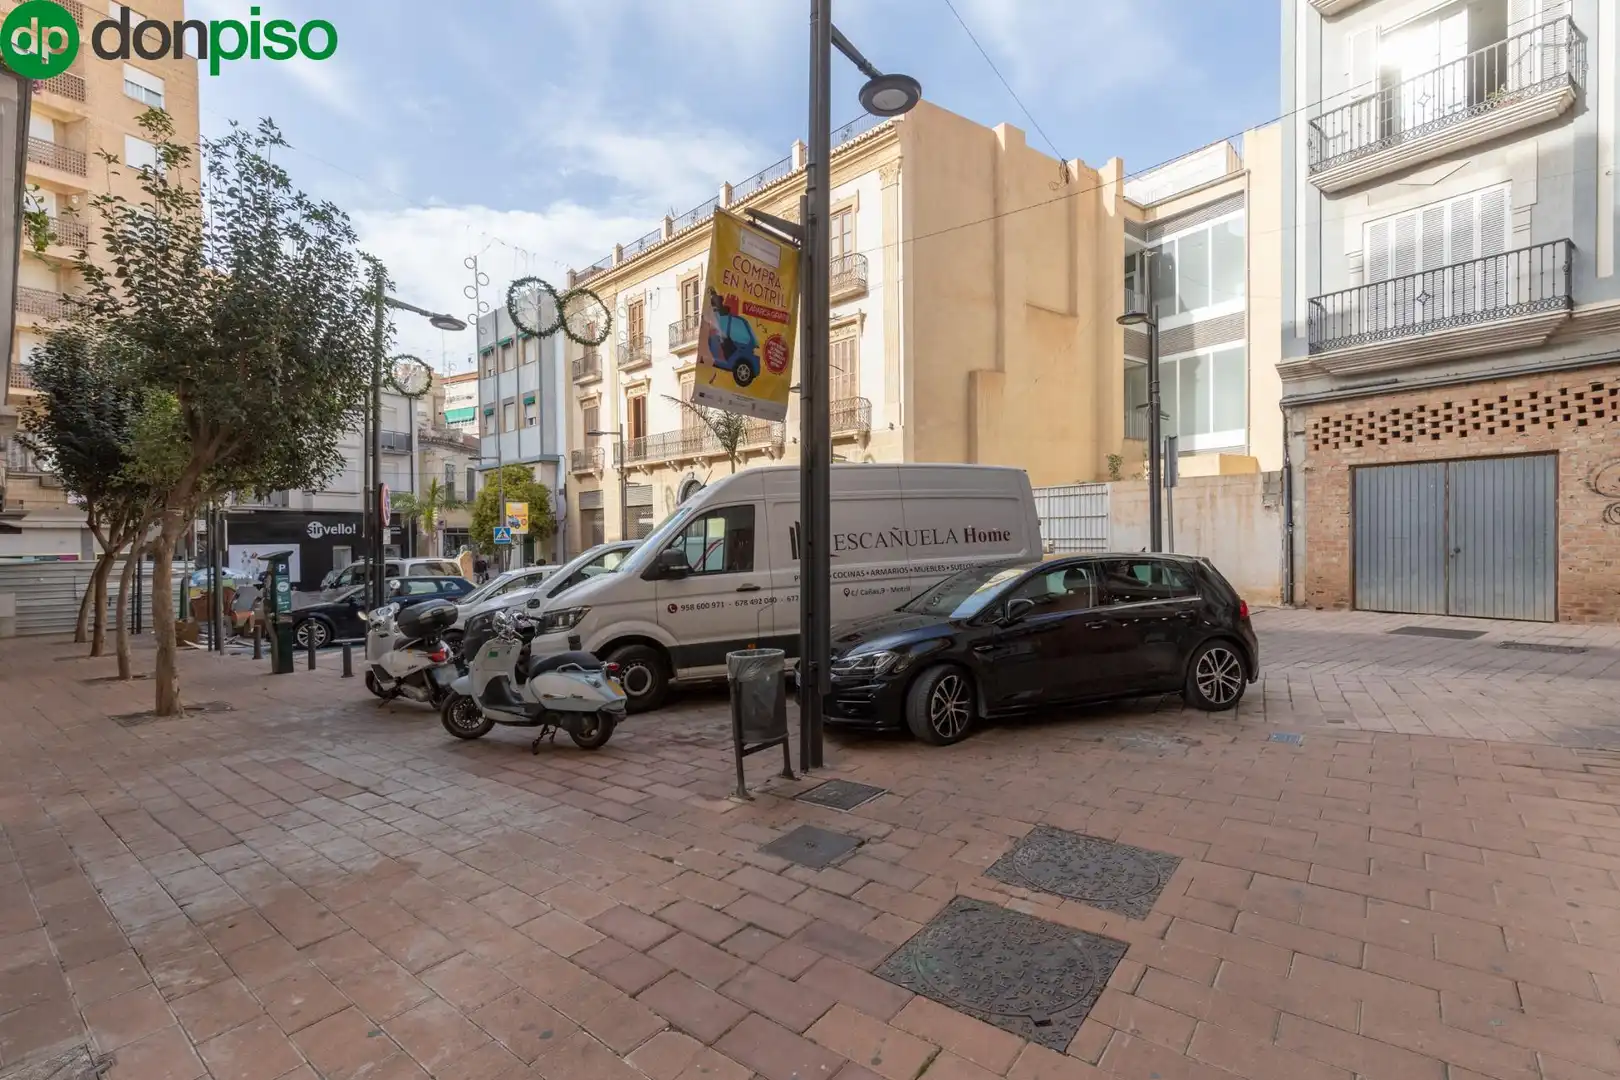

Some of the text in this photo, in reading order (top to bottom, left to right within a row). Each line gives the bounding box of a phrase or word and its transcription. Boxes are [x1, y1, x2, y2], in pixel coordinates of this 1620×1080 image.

[732, 255, 782, 290] COMPRA
[722, 269, 787, 308] EN MOTRIL
[306, 522, 357, 536] sinvello!
[833, 525, 1011, 551] ESCAÑUELA Home
[278, 563, 287, 573] P
[832, 571, 866, 579] COCINAS
[870, 567, 909, 577] ARMARIOS
[913, 565, 946, 573] MUEBLES
[680, 603, 695, 612] 958
[696, 602, 710, 610] 600
[711, 600, 725, 609] 971
[734, 599, 749, 607] 678
